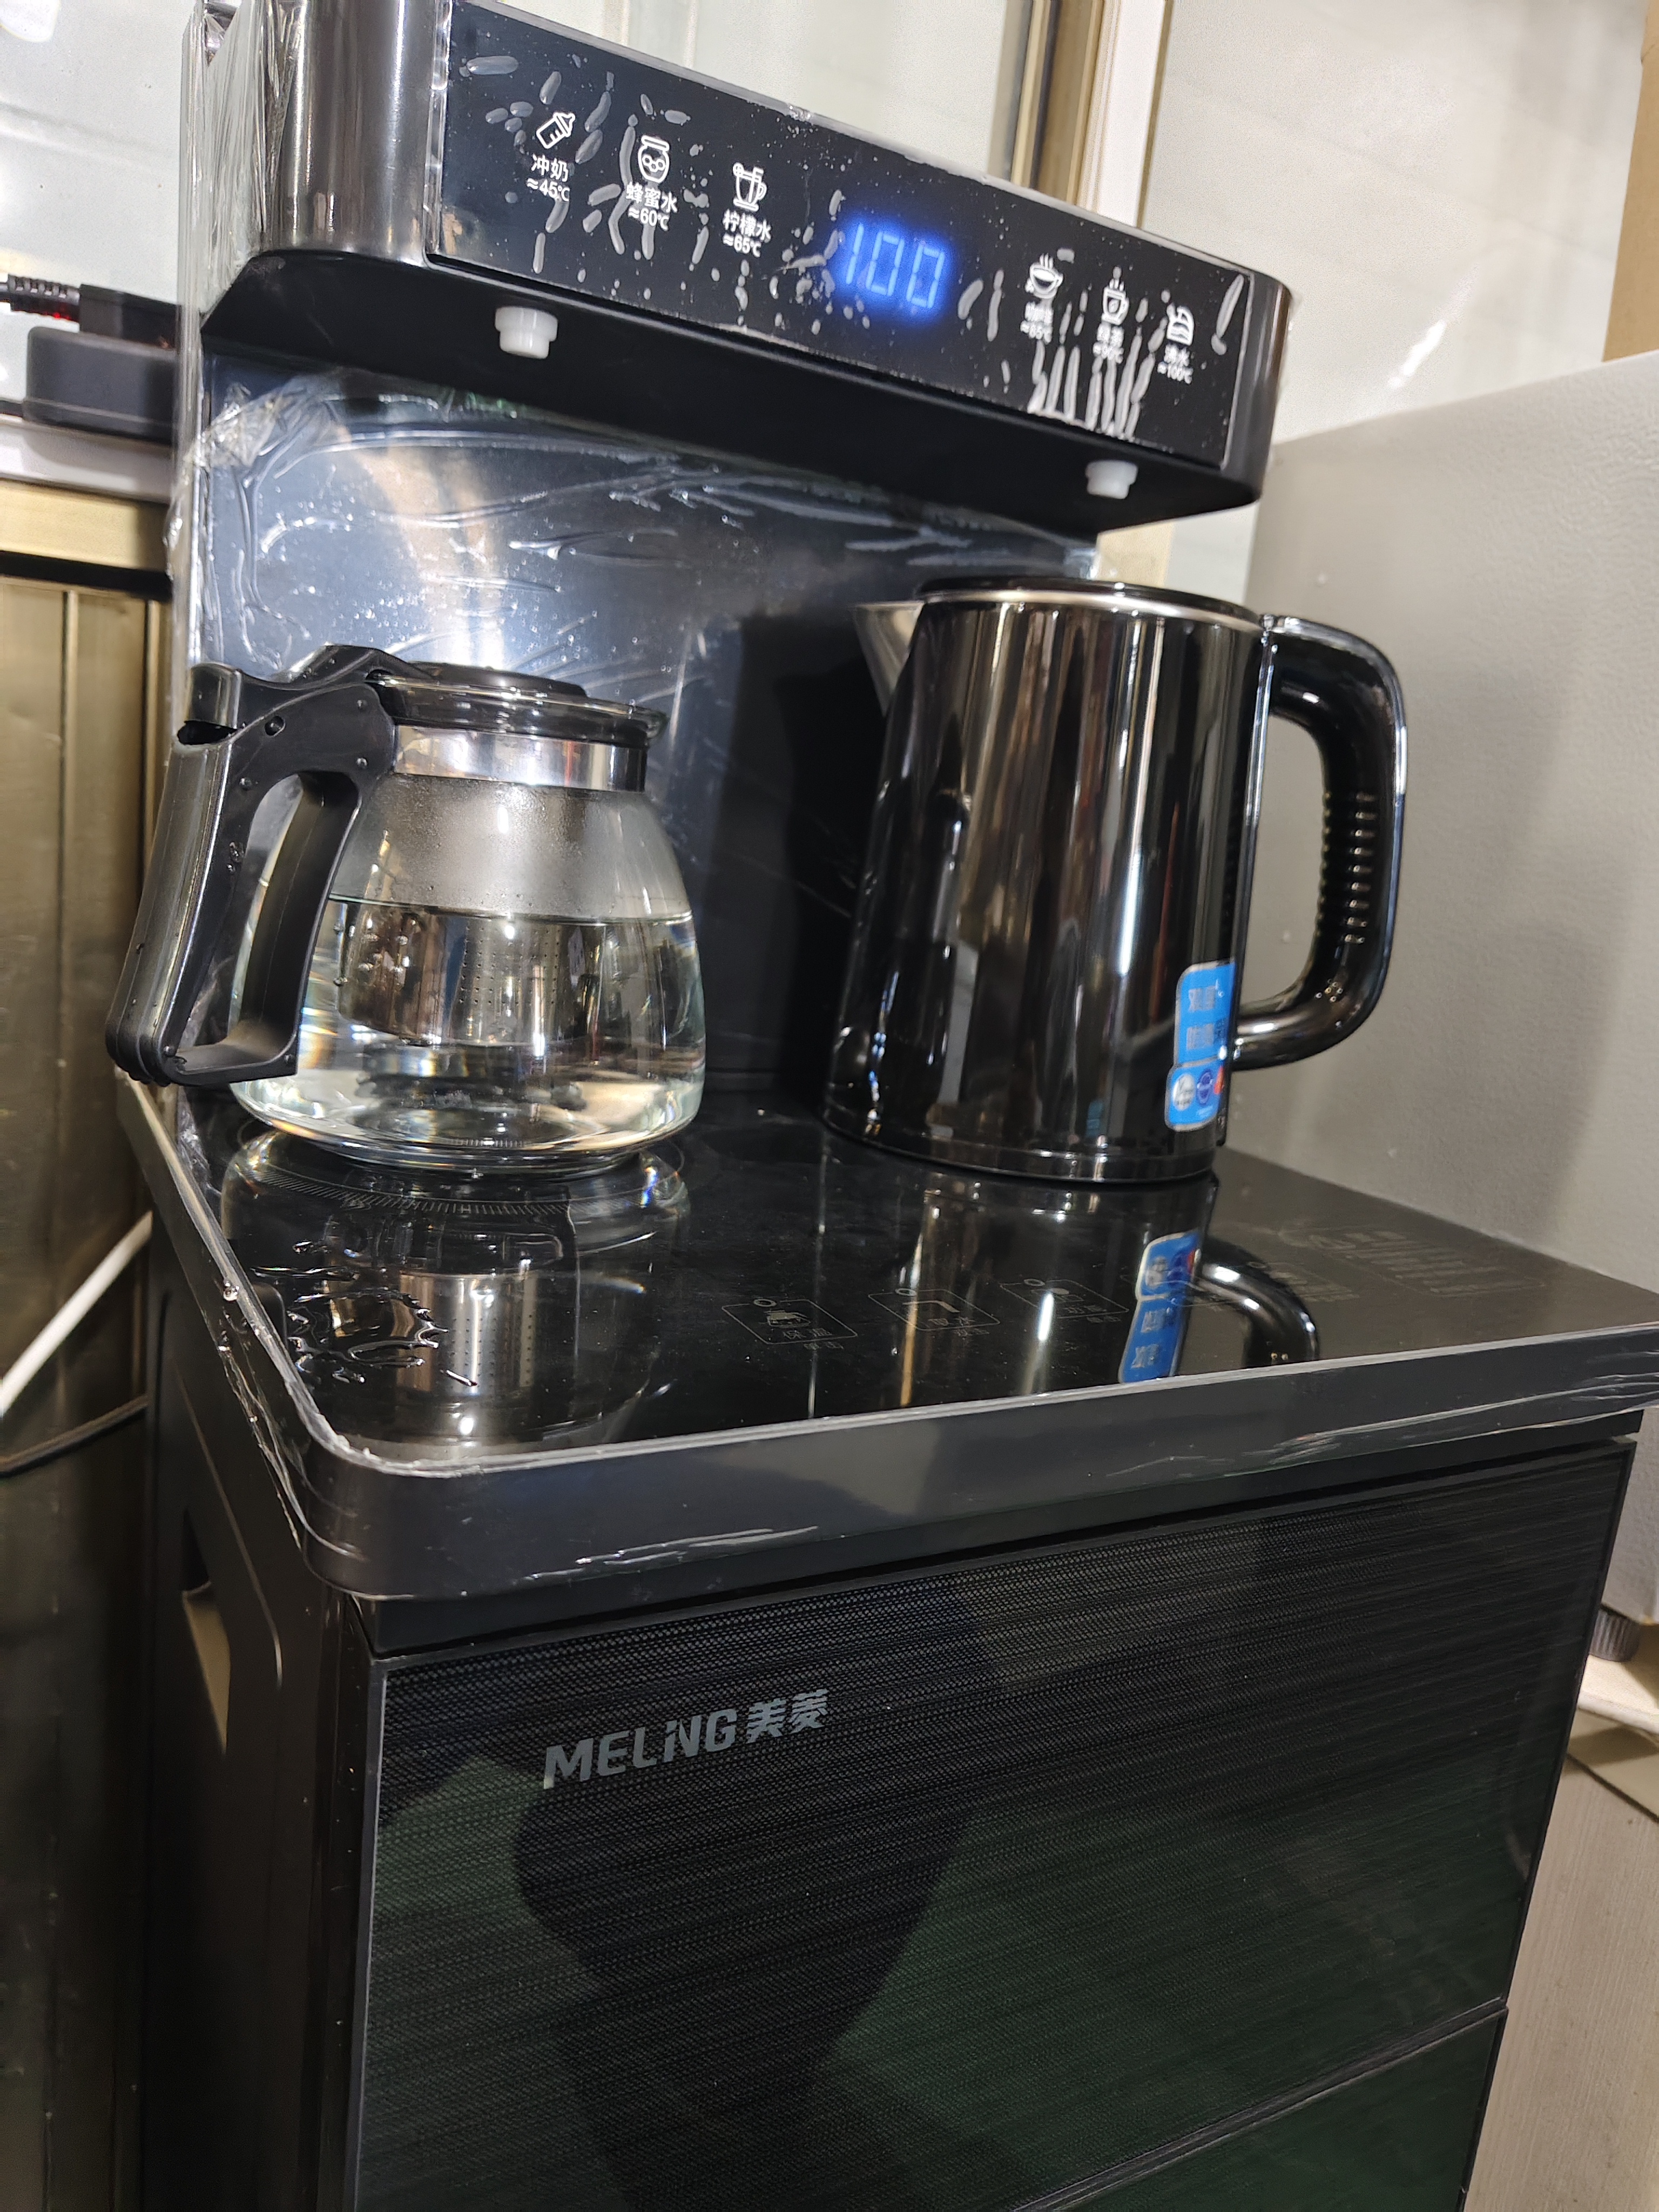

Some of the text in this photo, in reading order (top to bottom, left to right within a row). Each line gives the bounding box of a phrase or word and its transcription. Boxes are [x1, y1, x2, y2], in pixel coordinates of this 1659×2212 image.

[531, 153, 569, 182] 冲奶
[626, 181, 678, 213] 蜂蜜水
[723, 208, 771, 241] 柠檬水
[846, 222, 945, 308] 100
[783, 1328, 832, 1339] 保温
[928, 1317, 976, 1326] 取水
[746, 1689, 828, 1743] 美菱
